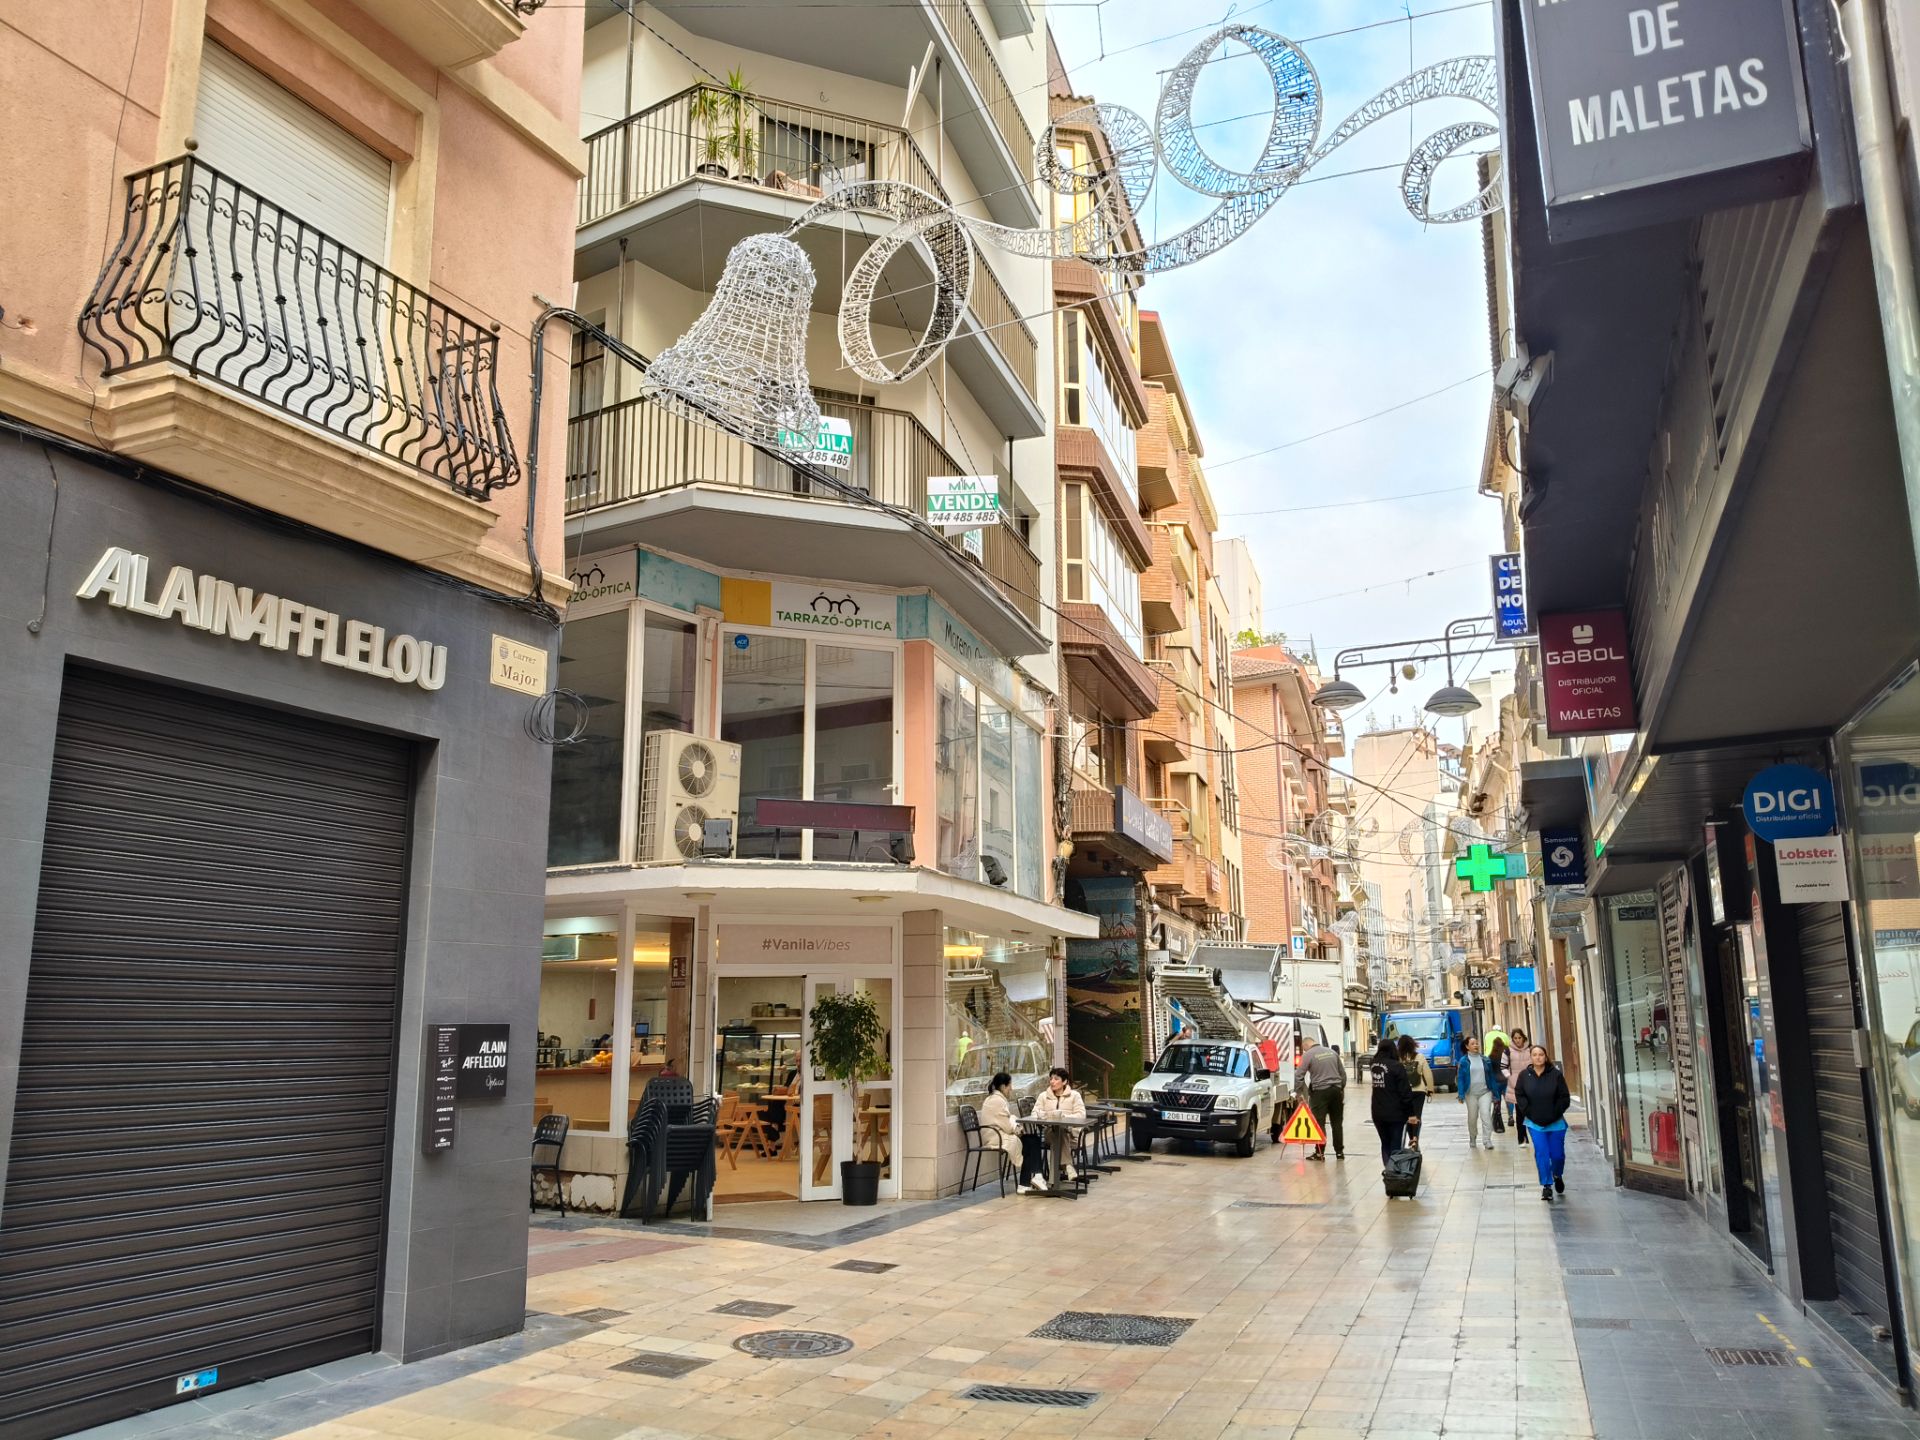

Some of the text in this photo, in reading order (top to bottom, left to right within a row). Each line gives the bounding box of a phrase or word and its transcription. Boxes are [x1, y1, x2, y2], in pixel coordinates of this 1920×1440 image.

[1628, 1, 1684, 57] DE
[1568, 58, 1768, 145] MALETAS
[807, 451, 828, 462] 485
[830, 453, 849, 466] 485
[929, 494, 994, 510] VENDE
[932, 511, 995, 522] 744 485 485
[1499, 576, 1522, 590] DE
[512, 649, 537, 664] Carrer
[500, 663, 539, 687] Major
[1558, 675, 1617, 687] DISTRIBUIDOR
[1571, 687, 1605, 696] OFICIAL
[1559, 706, 1622, 721] MALETAS
[1753, 788, 1821, 814] DIGI
[1756, 814, 1797, 823] Distribuidor
[762, 938, 851, 951] #VanilaVibes
[479, 1041, 507, 1054] ALAIN
[462, 1055, 506, 1069] AFFLELOU
